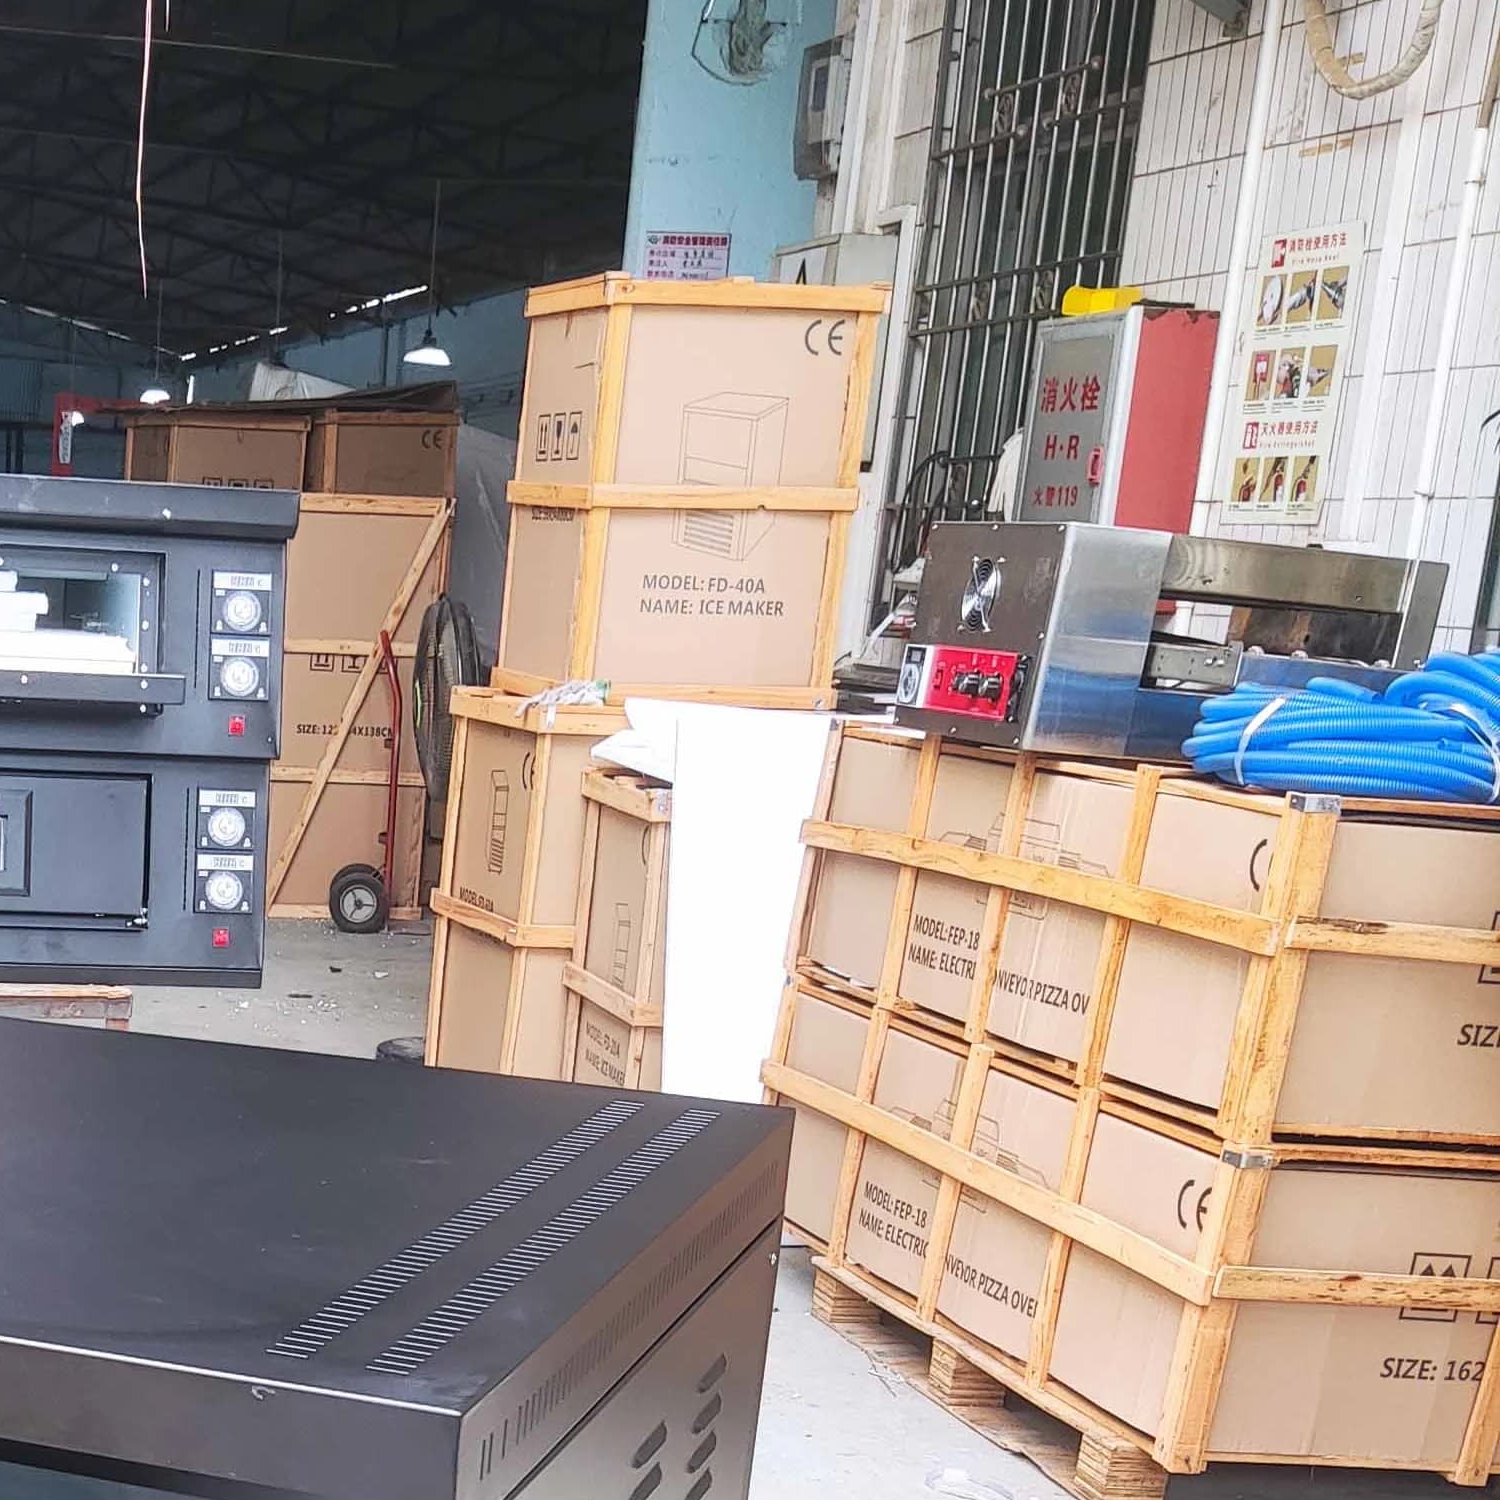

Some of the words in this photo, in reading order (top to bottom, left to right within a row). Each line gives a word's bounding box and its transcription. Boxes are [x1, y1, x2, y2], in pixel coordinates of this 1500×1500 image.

[805, 319, 845, 356] CE
[1041, 375, 1101, 412] 消火栓
[642, 574, 704, 591] MODEL:
[707, 577, 765, 593] FD-40A
[640, 598, 693, 614] NAME:
[699, 600, 725, 615] ICE
[727, 601, 784, 616] MAKER
[297, 723, 320, 735] SIZE:
[913, 914, 947, 941] MODEL:
[948, 925, 980, 951] FEP-18
[908, 943, 937, 970] NAME:
[938, 953, 977, 981] ELECTRI
[1034, 984, 1069, 1011] PIZZA
[864, 1181, 893, 1213] MODEL:
[894, 1199, 928, 1229] FEP-18
[859, 1208, 885, 1238] NAME:
[978, 1273, 1008, 1305] PIZZA
[1011, 1290, 1038, 1319] OVE
[1380, 1357, 1437, 1381] SIZE:
